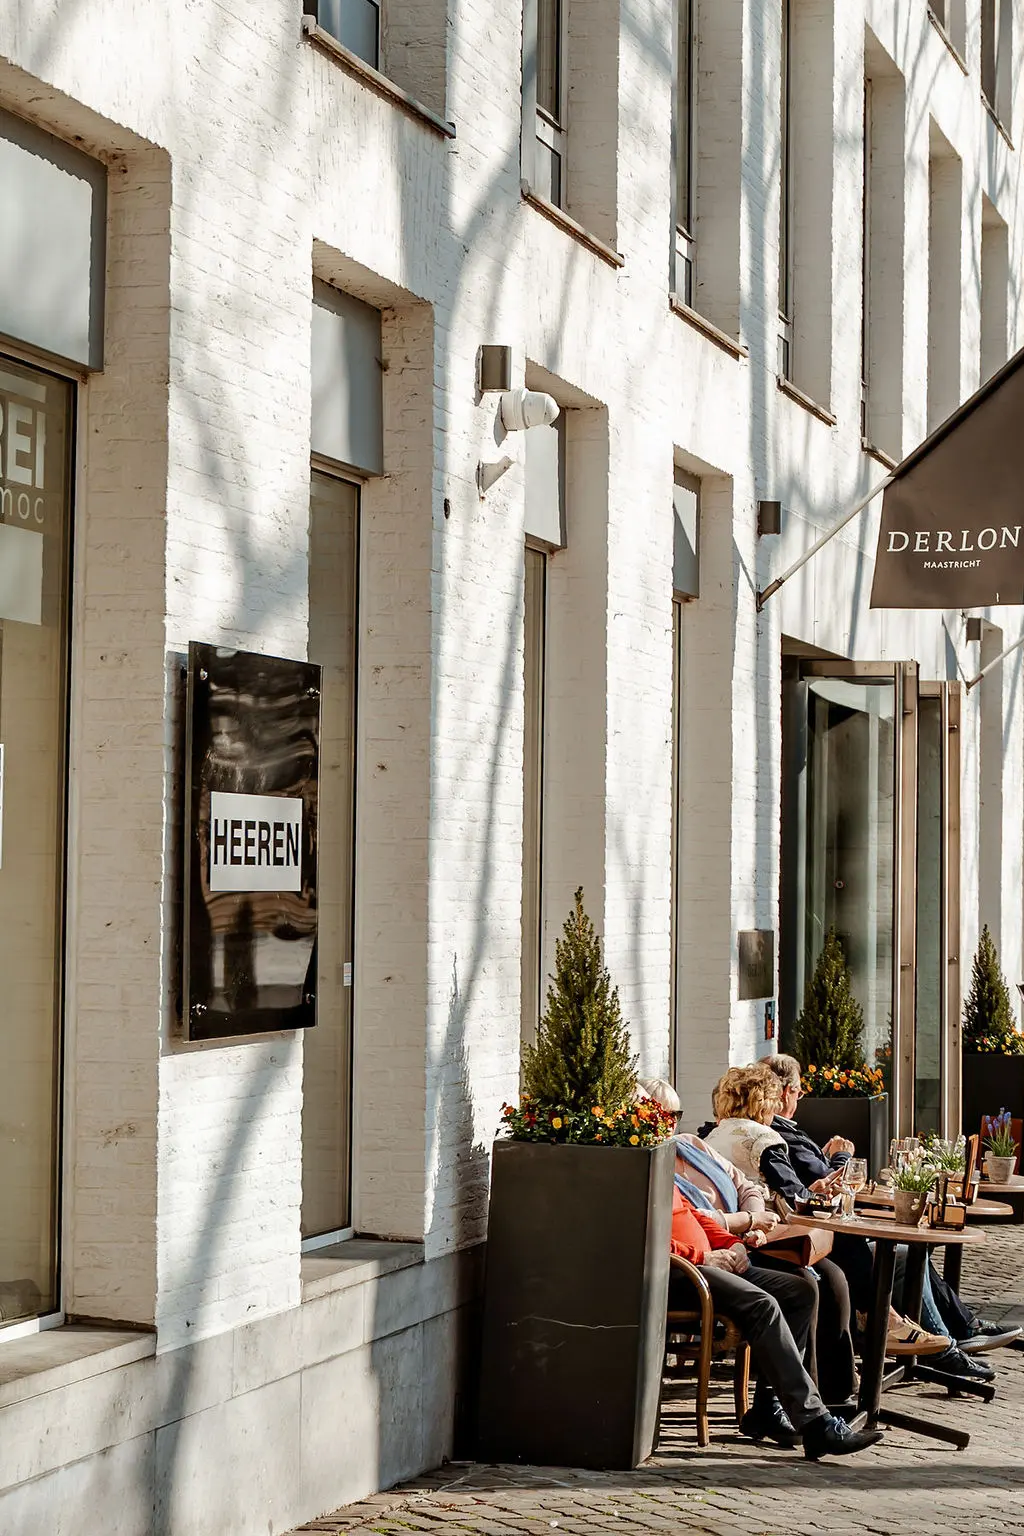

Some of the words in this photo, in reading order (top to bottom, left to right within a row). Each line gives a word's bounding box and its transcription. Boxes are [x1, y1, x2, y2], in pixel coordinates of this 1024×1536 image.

[886, 525, 1022, 552] DERLON
[923, 560, 981, 569] MAASTRICHT
[213, 818, 300, 867] HEEREN
